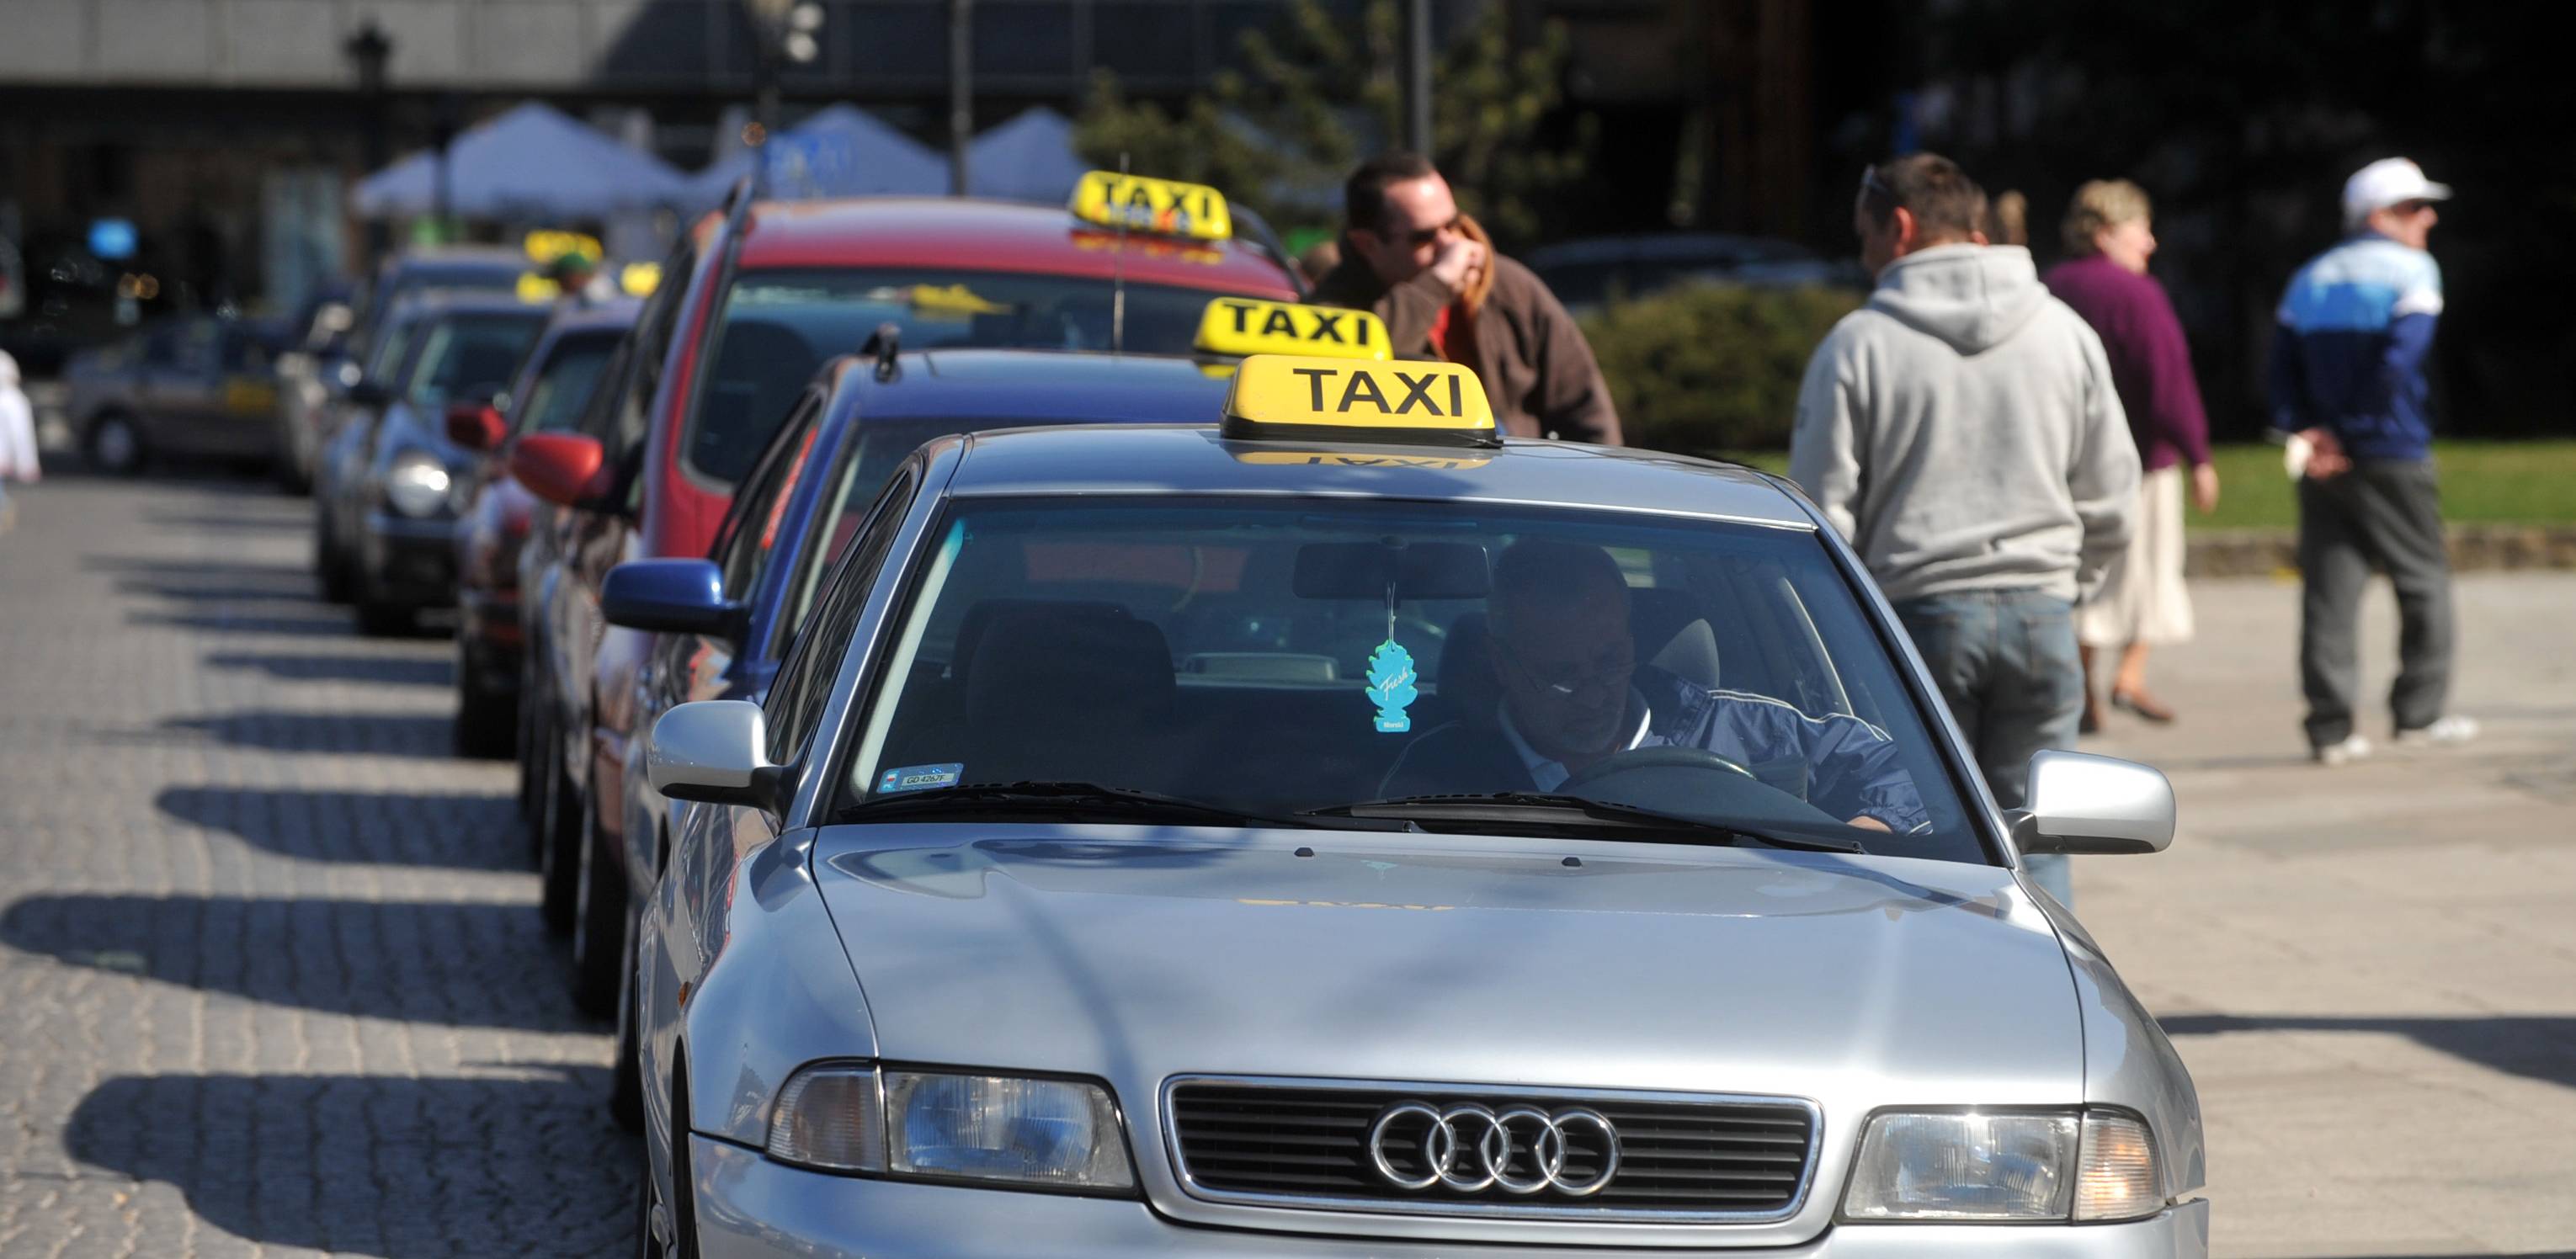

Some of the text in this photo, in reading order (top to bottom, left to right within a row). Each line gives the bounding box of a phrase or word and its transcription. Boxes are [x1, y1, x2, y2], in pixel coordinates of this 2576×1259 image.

[1100, 179, 1211, 220] TAXI
[1221, 302, 1369, 347] TAXI
[1292, 368, 1463, 417] TAXI
[1379, 666, 1408, 701] Fresh
[907, 776, 920, 784] GD
